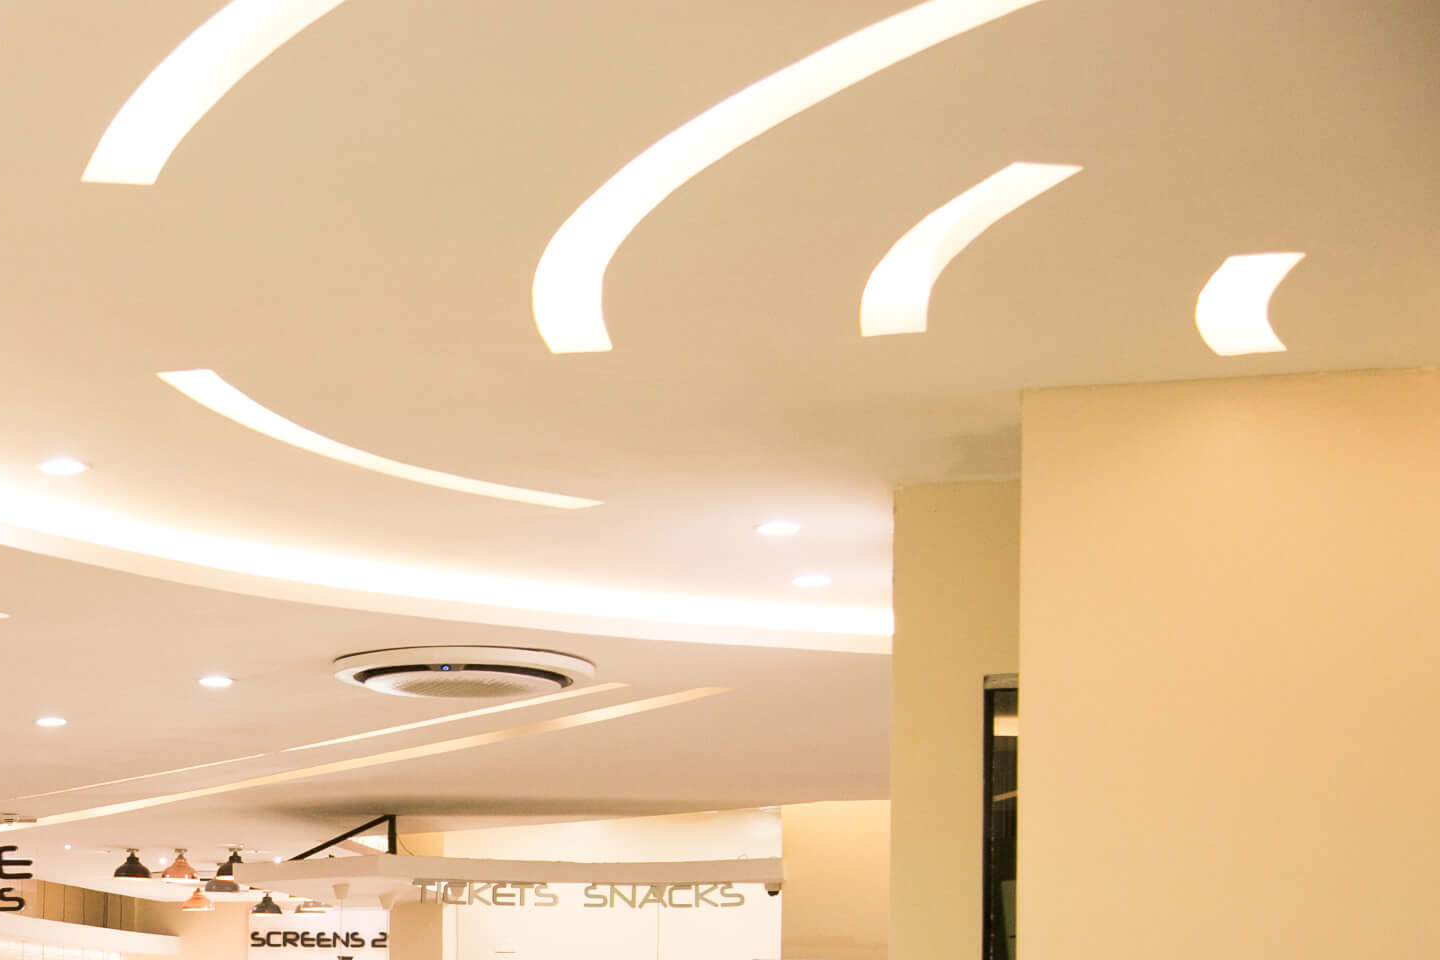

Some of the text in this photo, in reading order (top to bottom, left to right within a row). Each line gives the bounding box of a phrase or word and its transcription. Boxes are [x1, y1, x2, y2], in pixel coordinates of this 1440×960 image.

[413, 879, 746, 909] TICKETS SNACKS
[250, 931, 365, 948] SCREENS
